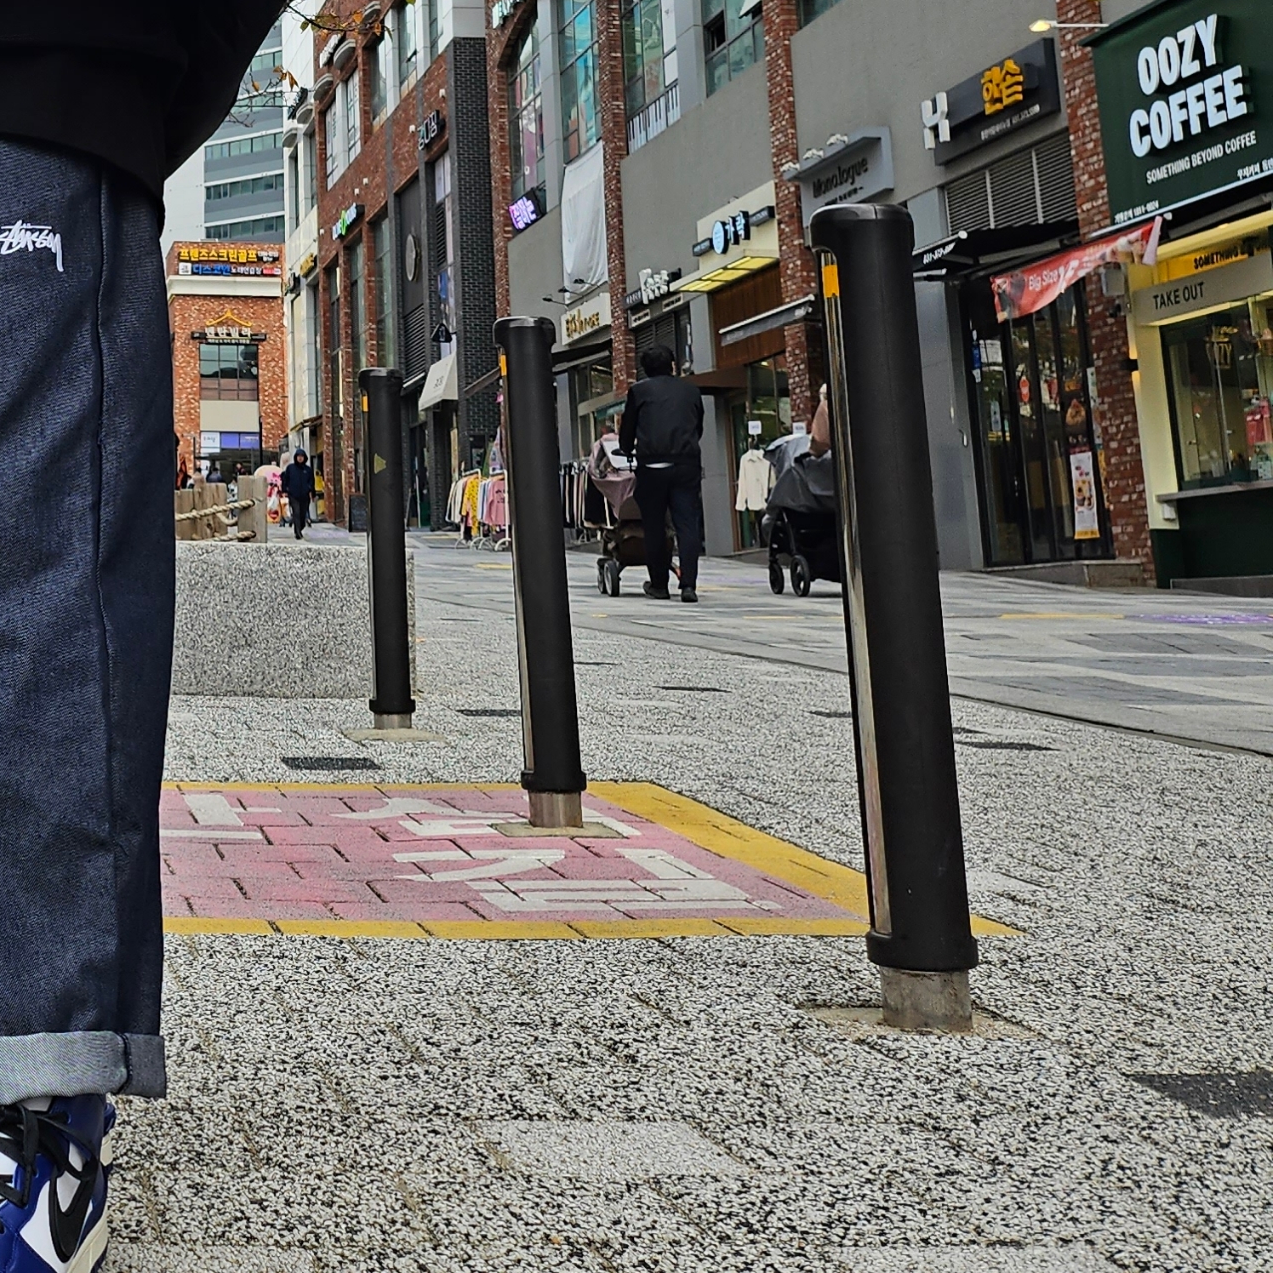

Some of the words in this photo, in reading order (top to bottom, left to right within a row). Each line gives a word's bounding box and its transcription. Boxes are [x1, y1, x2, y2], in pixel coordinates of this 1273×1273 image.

[1138, 14, 1218, 95] OOZY
[1129, 65, 1248, 158] COFFEE
[1147, 155, 1191, 185] SOMETHING
[1192, 142, 1224, 168] BEYOND
[1225, 130, 1257, 155] COFFEE
[180, 248, 257, 263] 프렌즈스크린골프
[1153, 289, 1180, 309] TAKE
[1182, 282, 1205, 303] OUT
